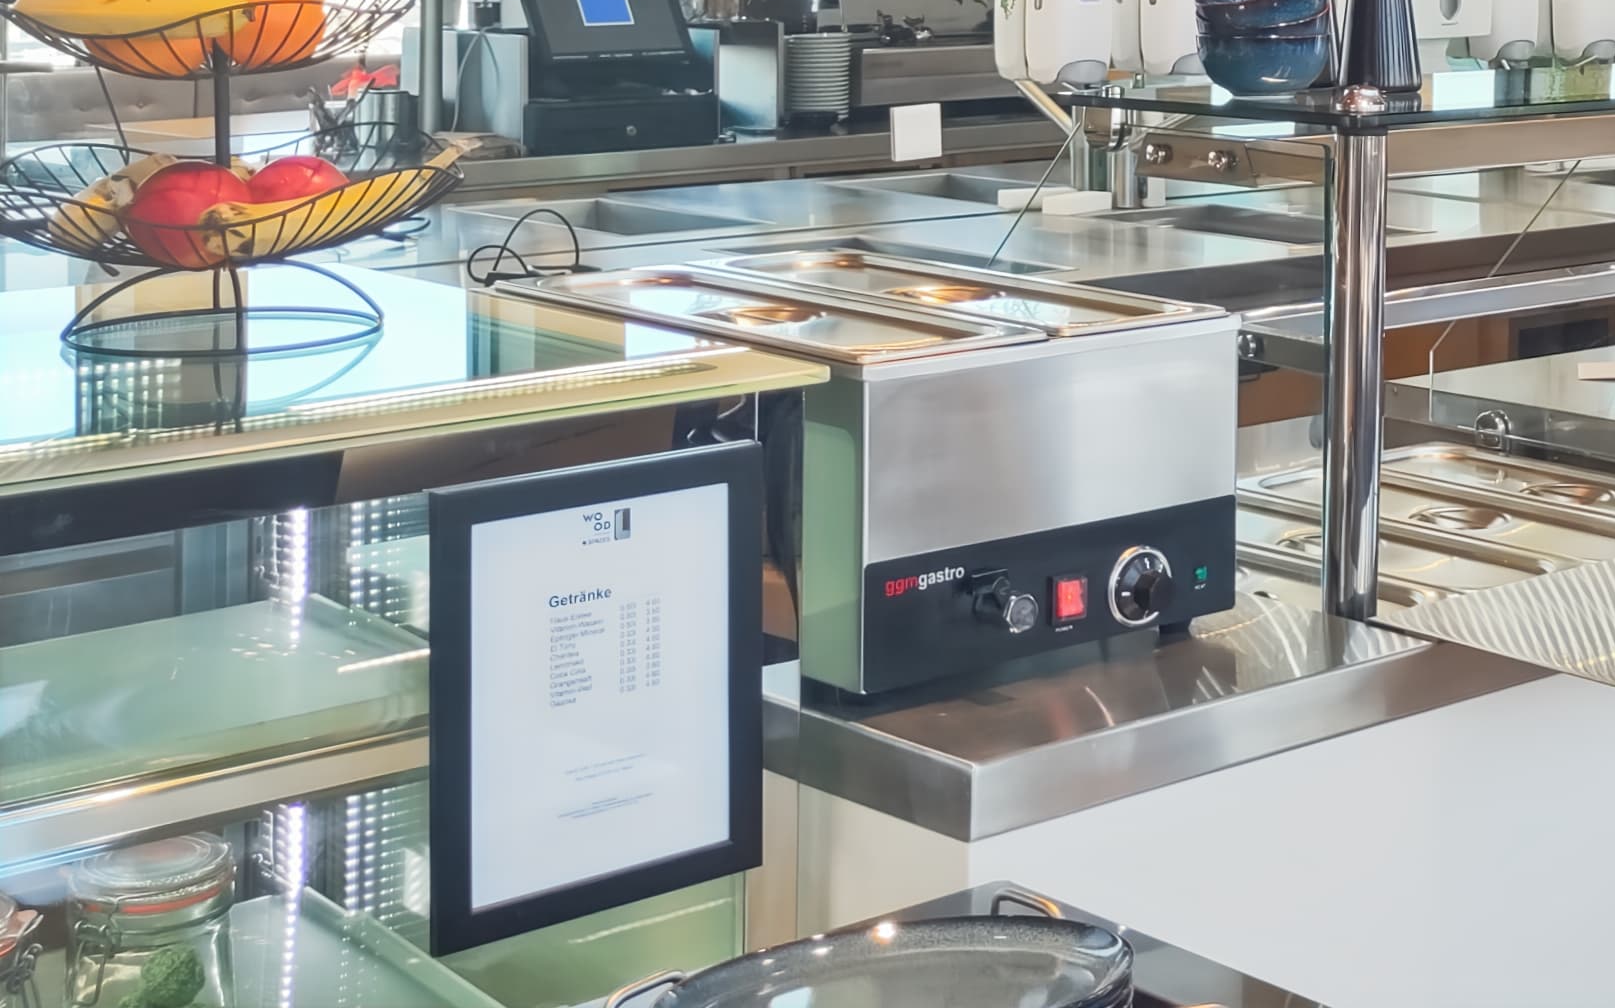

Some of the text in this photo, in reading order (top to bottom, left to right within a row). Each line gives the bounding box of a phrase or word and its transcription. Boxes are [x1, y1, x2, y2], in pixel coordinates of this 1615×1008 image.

[582, 511, 604, 522] WO
[593, 520, 612, 532] OD
[548, 587, 613, 608] Getränke
